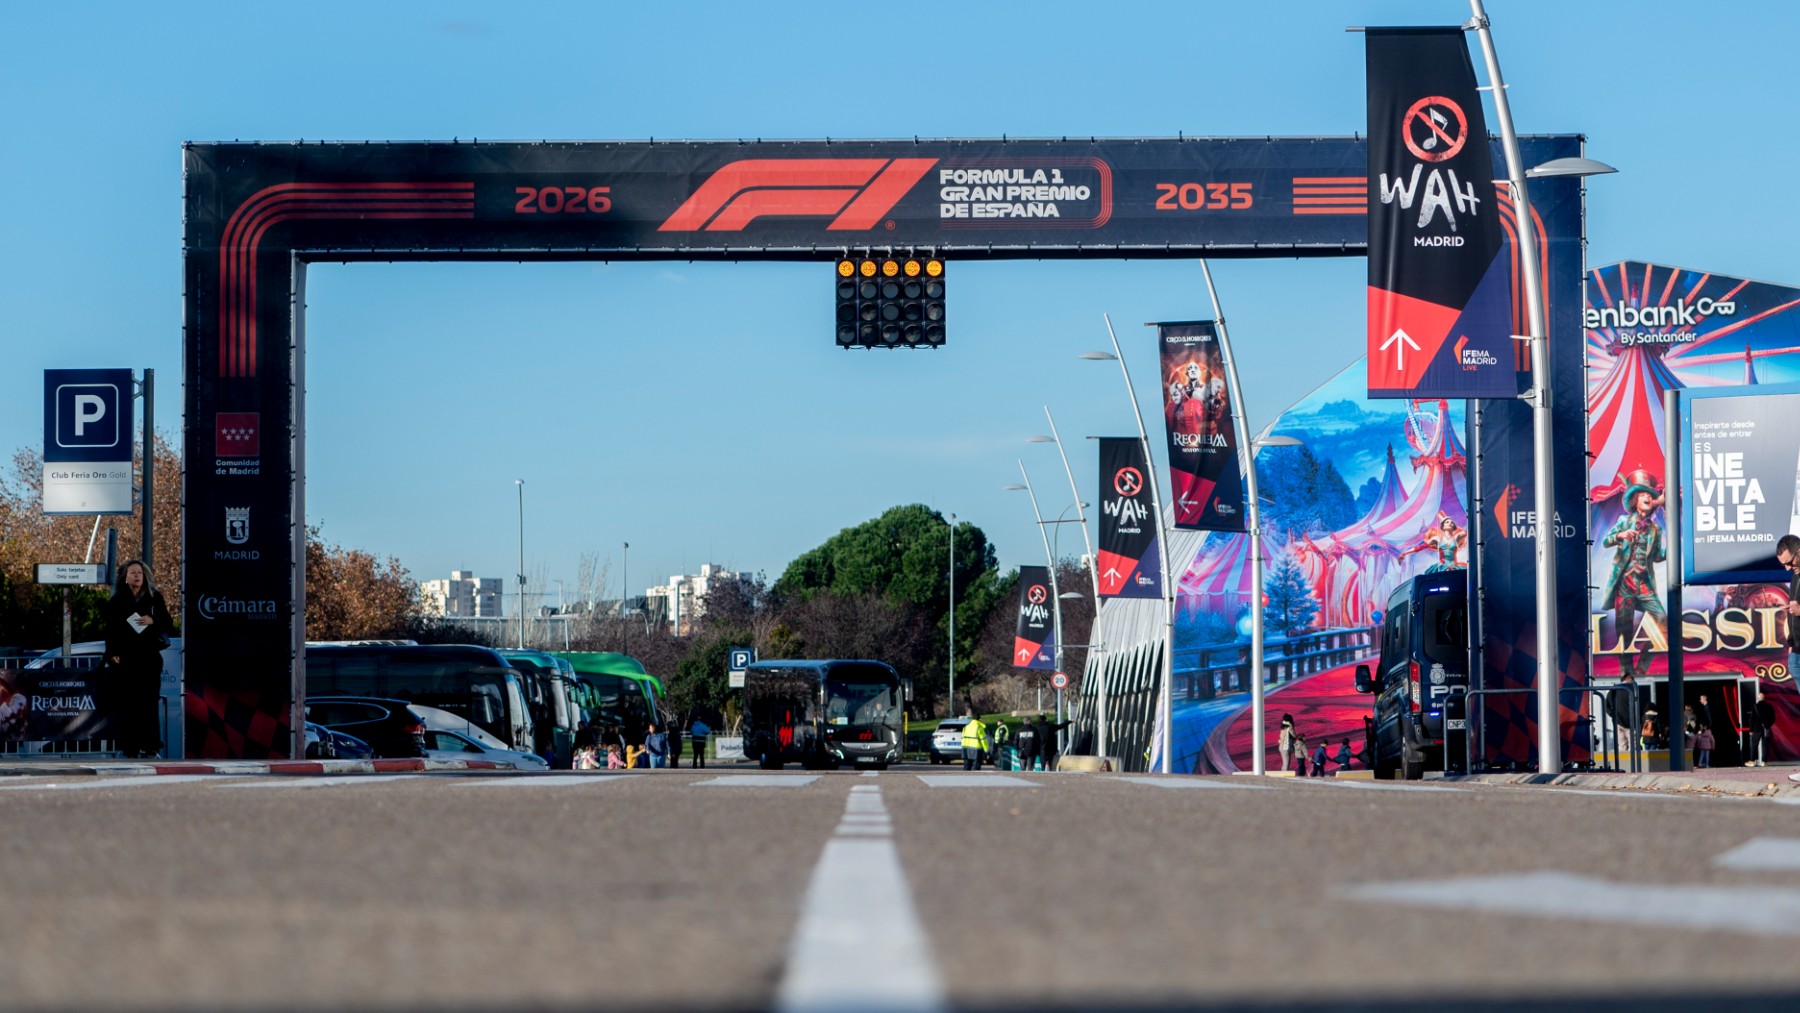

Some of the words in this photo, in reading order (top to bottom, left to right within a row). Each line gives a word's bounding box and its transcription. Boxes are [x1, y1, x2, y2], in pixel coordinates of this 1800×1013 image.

[940, 169, 1048, 184] FORMULA
[1052, 169, 1064, 184] 1
[515, 186, 611, 213] 2026
[940, 186, 1004, 202] GRAN
[1006, 185, 1090, 201] PREMIO
[1156, 183, 1253, 210] 2035
[1380, 163, 1480, 232] WAH
[940, 203, 968, 218] DE
[972, 201, 1060, 218] ESPAÑA
[1413, 236, 1465, 247] MADRID
[1621, 333, 1636, 346] By
[1637, 332, 1698, 344] Santander
[1462, 349, 1490, 357] IFEMA
[1462, 357, 1498, 365] MADRID
[75, 394, 106, 436] P
[1694, 422, 1730, 431] Inspirarte
[1731, 420, 1755, 429] desde
[1694, 431, 1716, 439] antes
[1717, 430, 1727, 438] de
[1729, 430, 1753, 438] entrar
[216, 467, 227, 475] de
[229, 467, 260, 475] Madrid
[1694, 452, 1744, 479] INE
[51, 471, 69, 479] Club
[71, 471, 90, 479] Feria
[92, 471, 107, 479] Oro
[109, 471, 127, 479] Gold
[1695, 478, 1766, 505] VITA
[1103, 496, 1149, 527] WAH
[1511, 511, 1562, 525] IFEA
[1696, 504, 1756, 532] BLE
[1511, 525, 1576, 538] MARID
[1707, 535, 1735, 543] IFEMA
[1736, 533, 1776, 542] MADRID.
[214, 551, 260, 560] MADRID
[203, 595, 276, 614] Cámara
[1021, 603, 1049, 624] WAH
[1592, 606, 1790, 655] LASSI
[736, 654, 746, 667] P
[1055, 676, 1065, 684] 20
